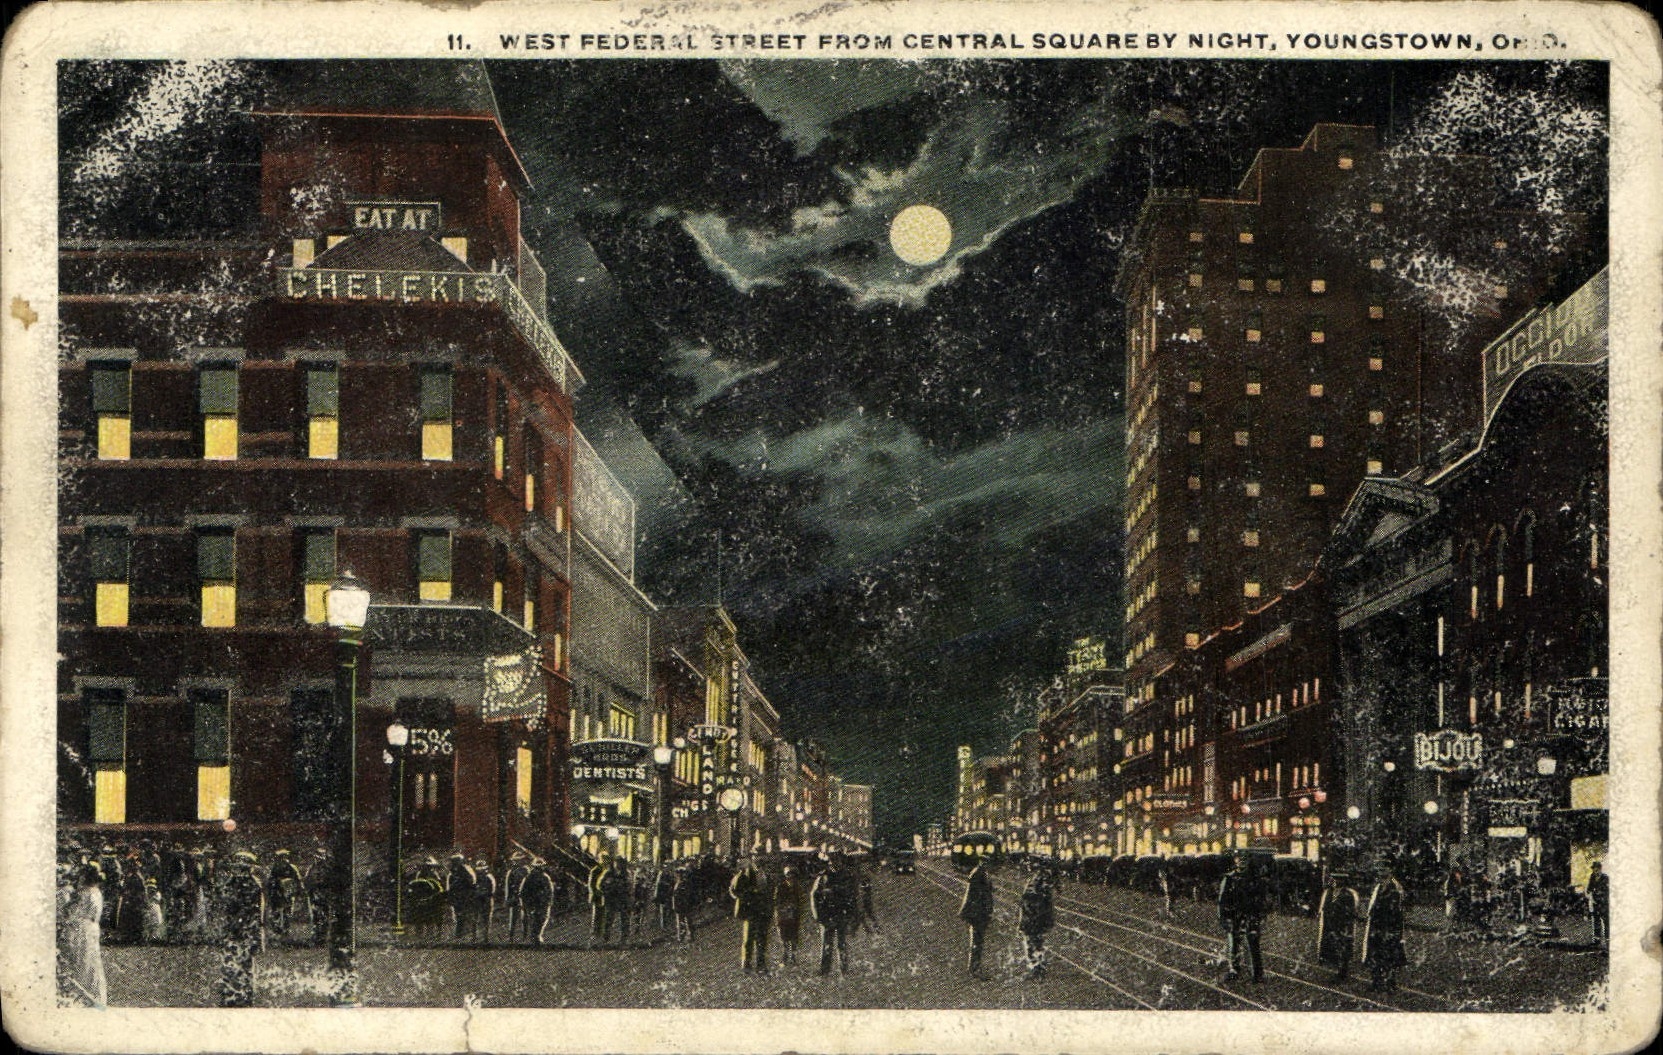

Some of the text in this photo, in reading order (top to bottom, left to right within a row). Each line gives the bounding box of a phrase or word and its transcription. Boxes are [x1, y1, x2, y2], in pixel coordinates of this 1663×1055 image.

[354, 207, 432, 231] EAT AT
[287, 270, 498, 303] CHELEKIS
[1420, 739, 1479, 762] BIJOU
[573, 765, 646, 780] DENTISTS
